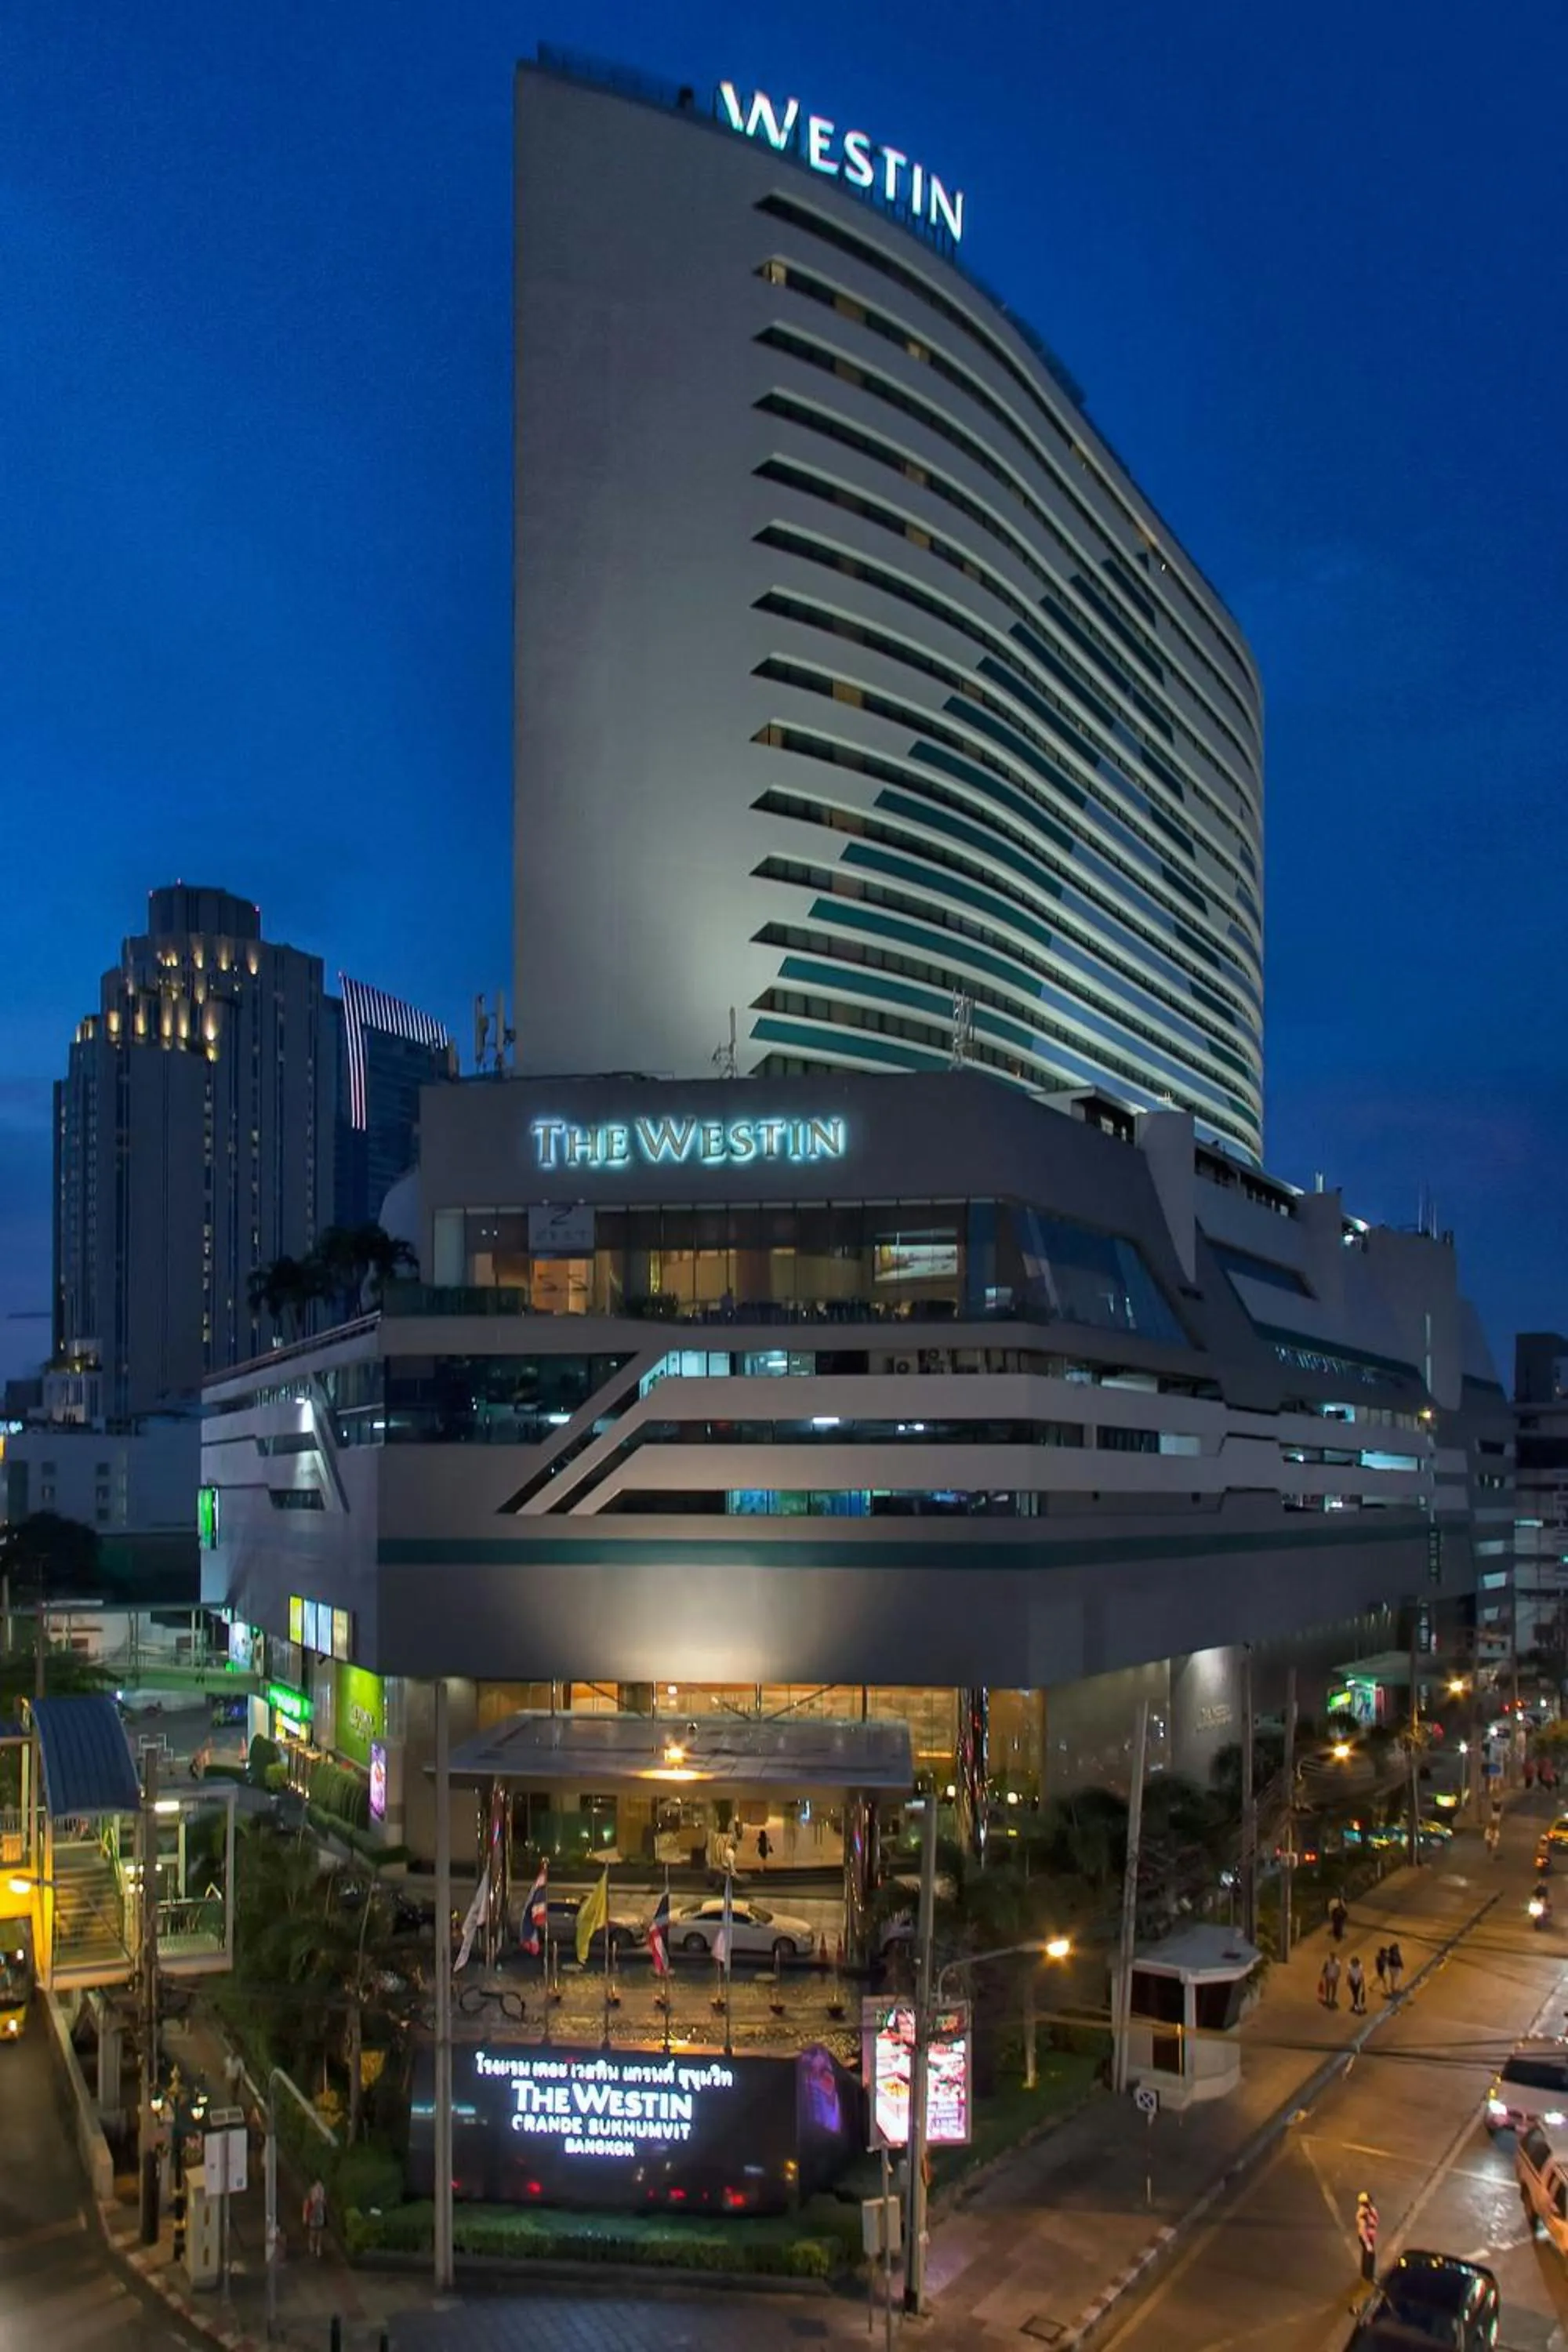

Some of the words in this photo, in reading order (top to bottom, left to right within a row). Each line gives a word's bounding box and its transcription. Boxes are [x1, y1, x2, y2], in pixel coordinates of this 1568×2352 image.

[720, 80, 964, 243] WESTIN
[531, 1119, 628, 1167] THE
[636, 1116, 845, 1163] WESTIN
[511, 2080, 571, 2114] THE
[572, 2082, 693, 2119] WESTIN
[512, 2114, 583, 2136] GRANDE
[588, 2118, 691, 2140] SUKHUMVIT
[564, 2138, 635, 2157] BANGKOK
